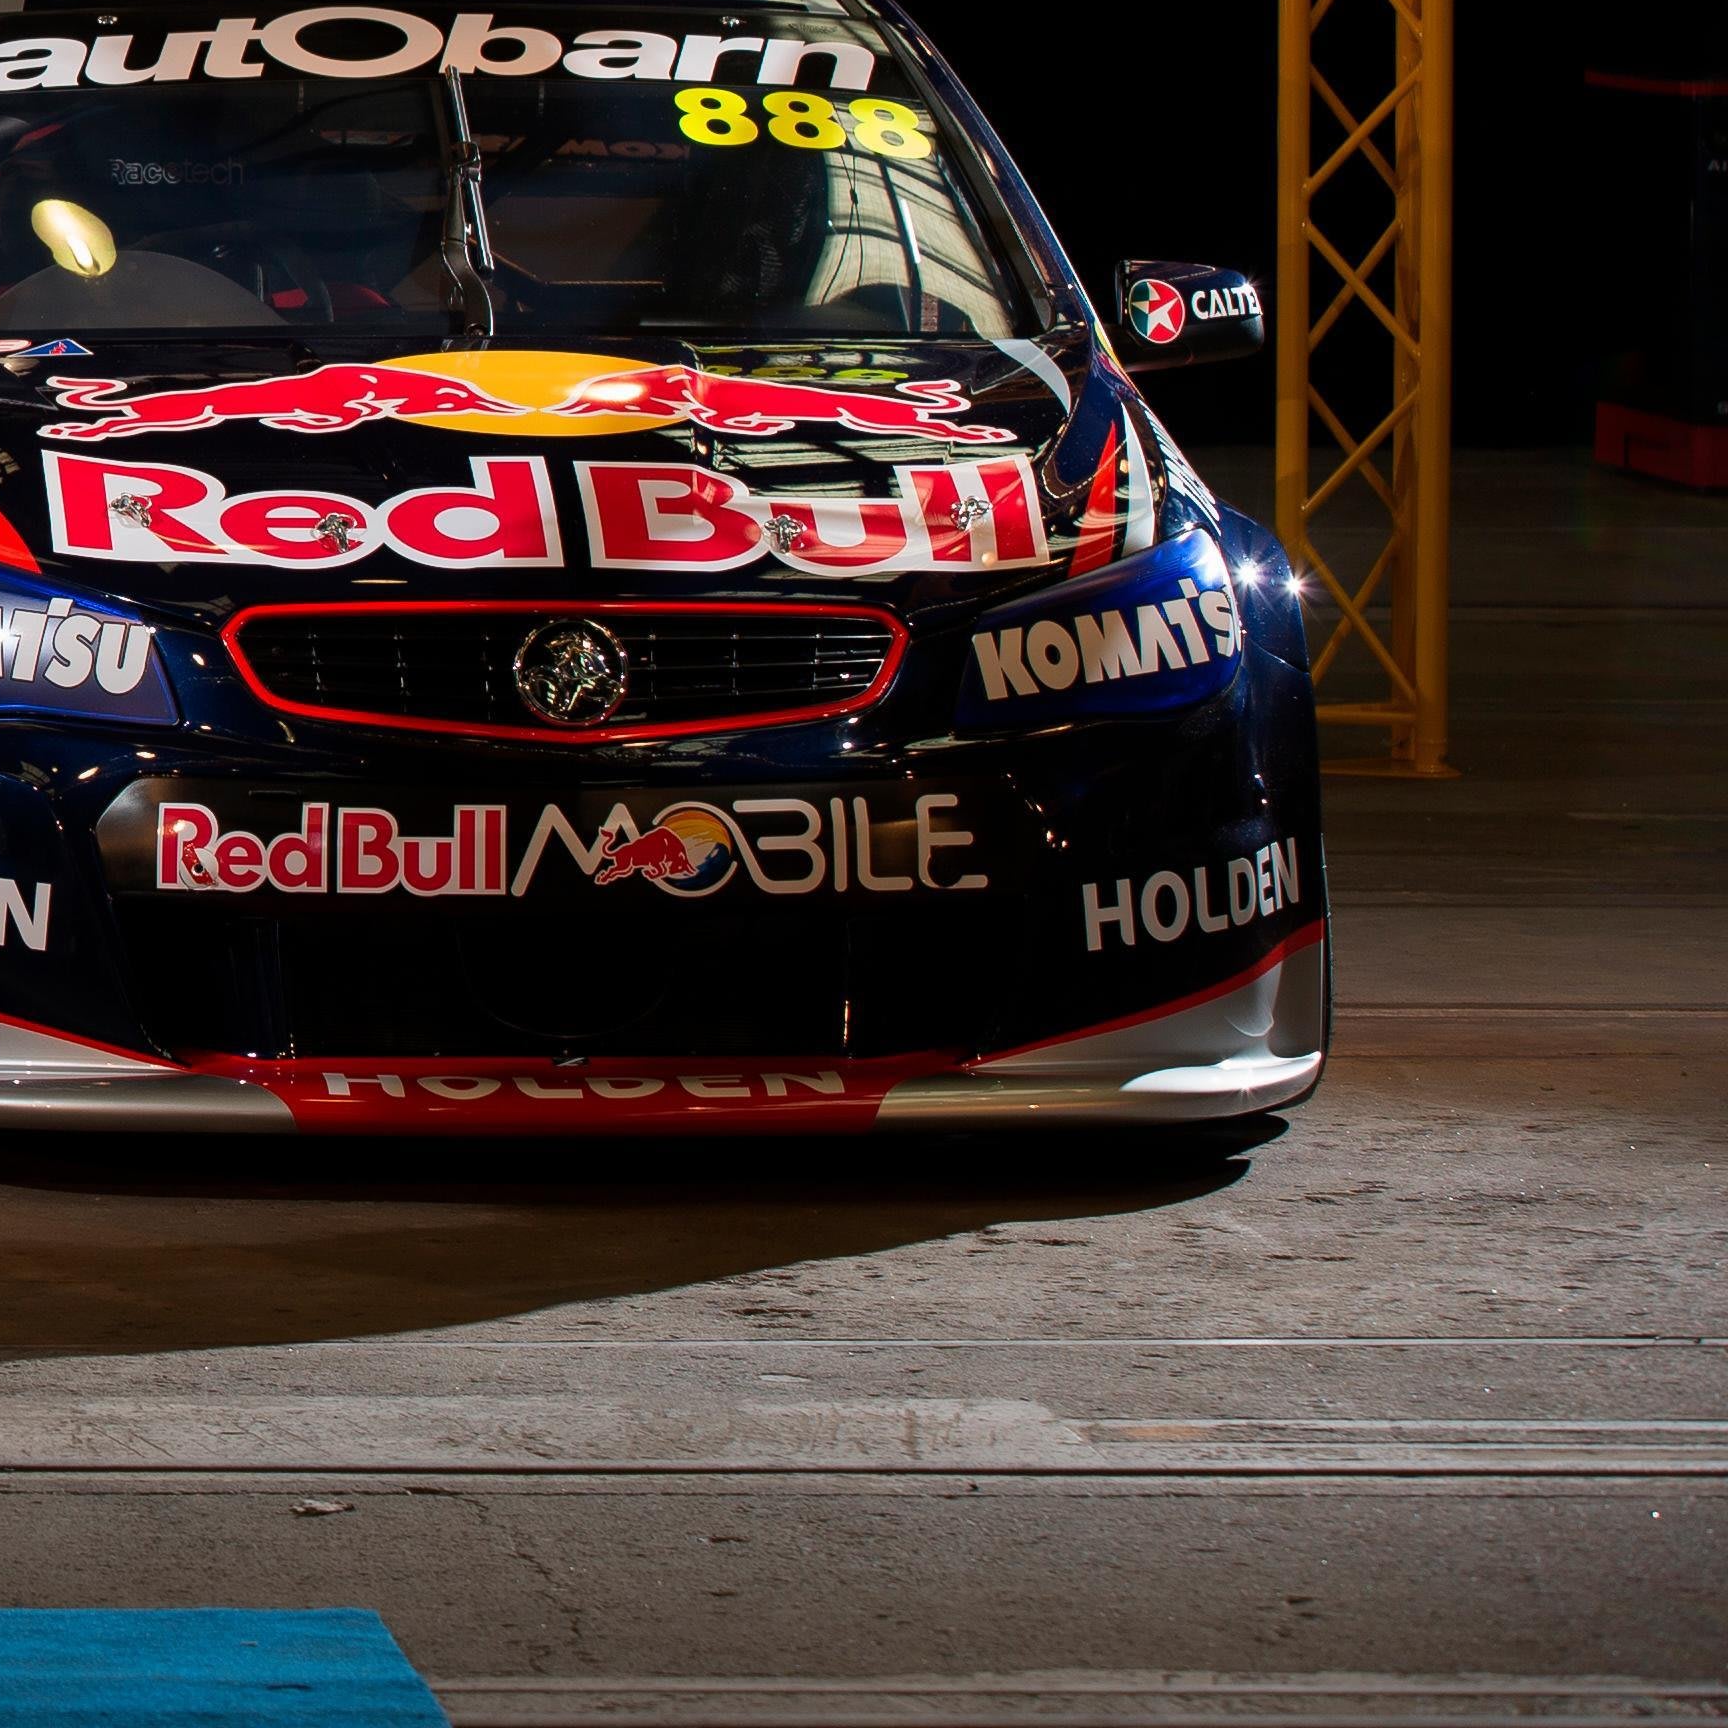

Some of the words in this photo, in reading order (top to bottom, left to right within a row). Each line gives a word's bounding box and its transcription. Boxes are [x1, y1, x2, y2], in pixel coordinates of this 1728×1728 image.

[672, 87, 934, 162] 888
[1191, 282, 1263, 320] CALTE
[41, 449, 565, 569] Red
[572, 453, 1051, 576] Bull
[971, 577, 1242, 701] KOMATS
[156, 801, 330, 894] Red
[335, 803, 508, 897] Bull
[510, 793, 990, 899] MOBILE
[1081, 836, 1301, 952] HOLDEN
[322, 1072, 846, 1101] HOLDEN
